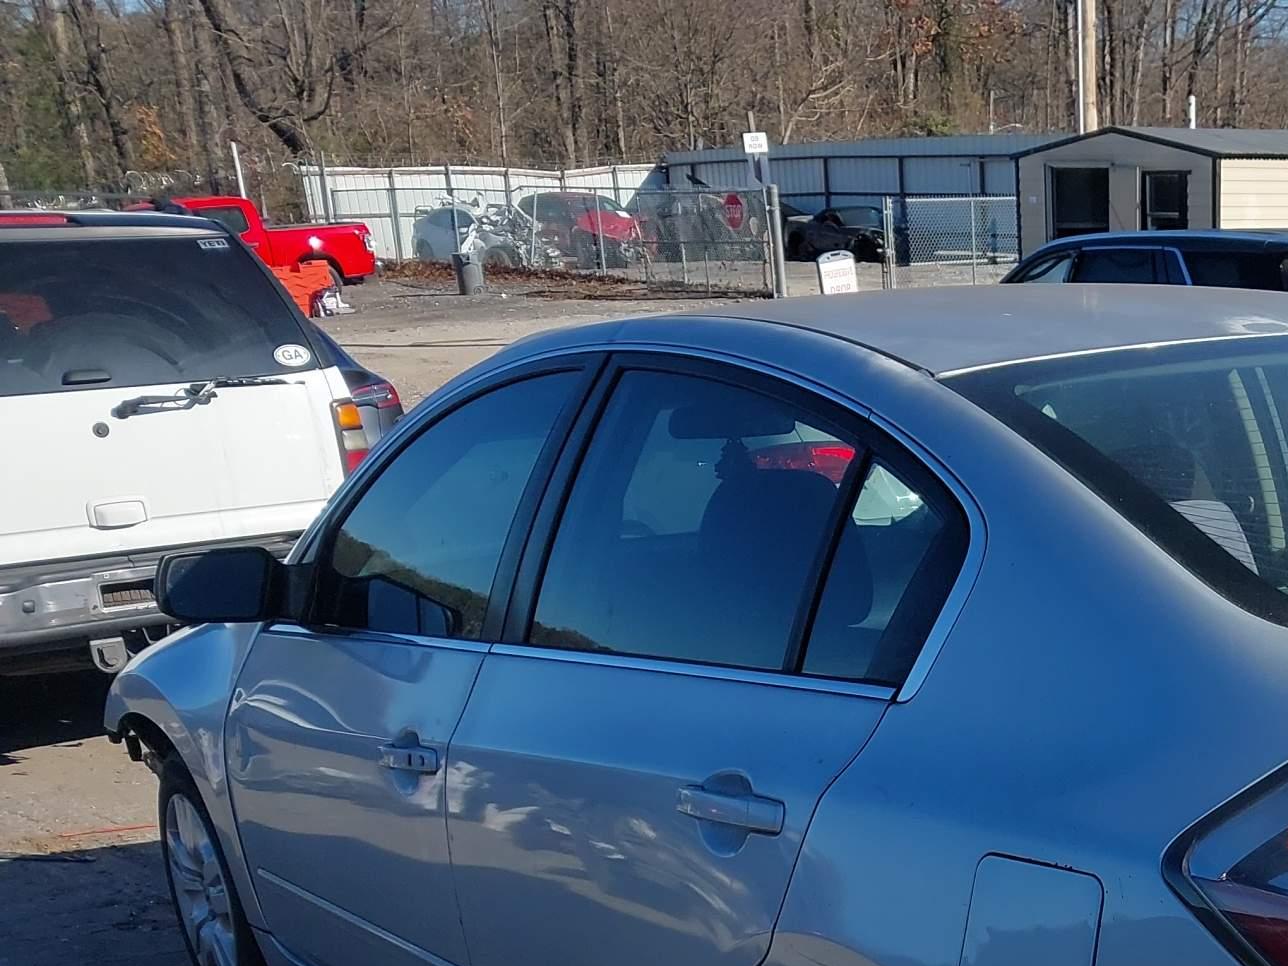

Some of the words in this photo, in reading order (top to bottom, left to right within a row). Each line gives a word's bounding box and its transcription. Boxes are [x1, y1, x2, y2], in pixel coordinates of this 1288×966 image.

[724, 204, 742, 218] STOP
[198, 239, 228, 248] YETI
[281, 349, 303, 361] GA
